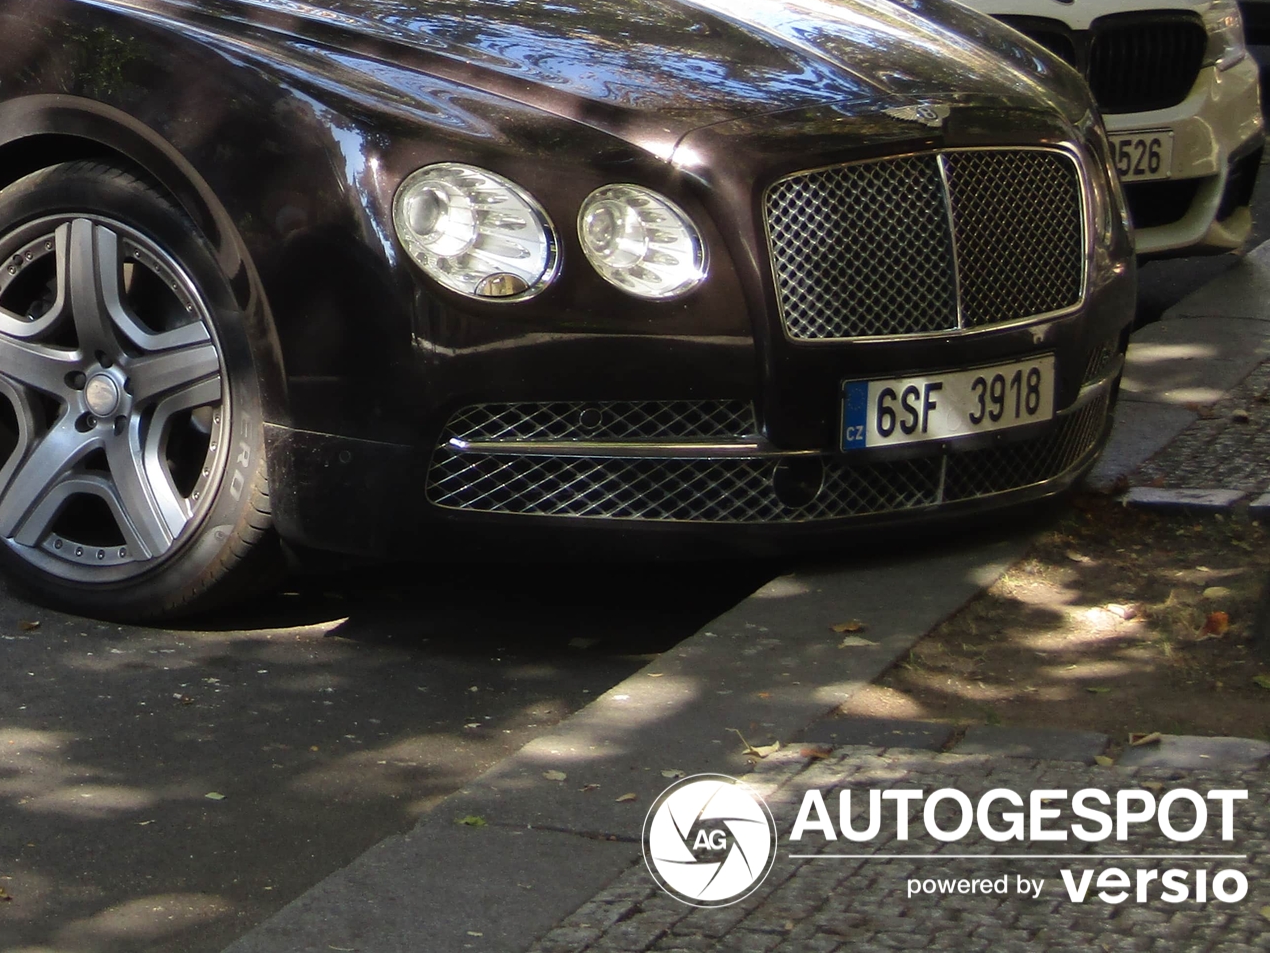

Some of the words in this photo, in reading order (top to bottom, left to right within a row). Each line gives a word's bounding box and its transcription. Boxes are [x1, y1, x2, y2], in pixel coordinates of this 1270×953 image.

[876, 381, 943, 438] 6SF
[968, 366, 1041, 426] 3918
[846, 425, 864, 442] CZ
